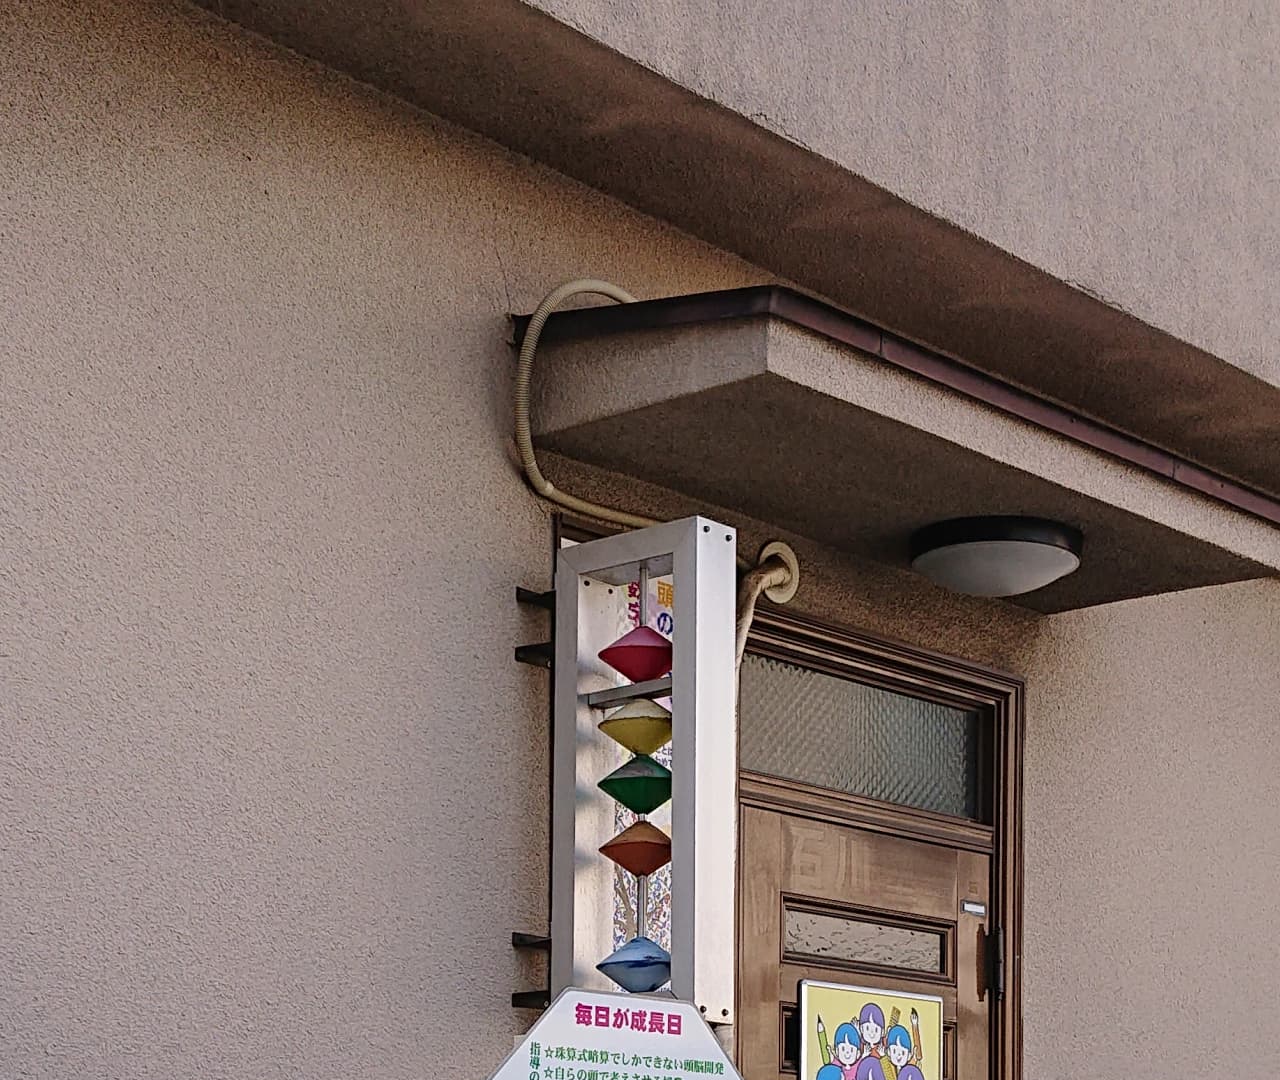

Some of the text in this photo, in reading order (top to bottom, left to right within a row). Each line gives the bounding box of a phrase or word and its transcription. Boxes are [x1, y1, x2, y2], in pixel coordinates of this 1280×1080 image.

[575, 1002, 682, 1035] 毎日が成長日
